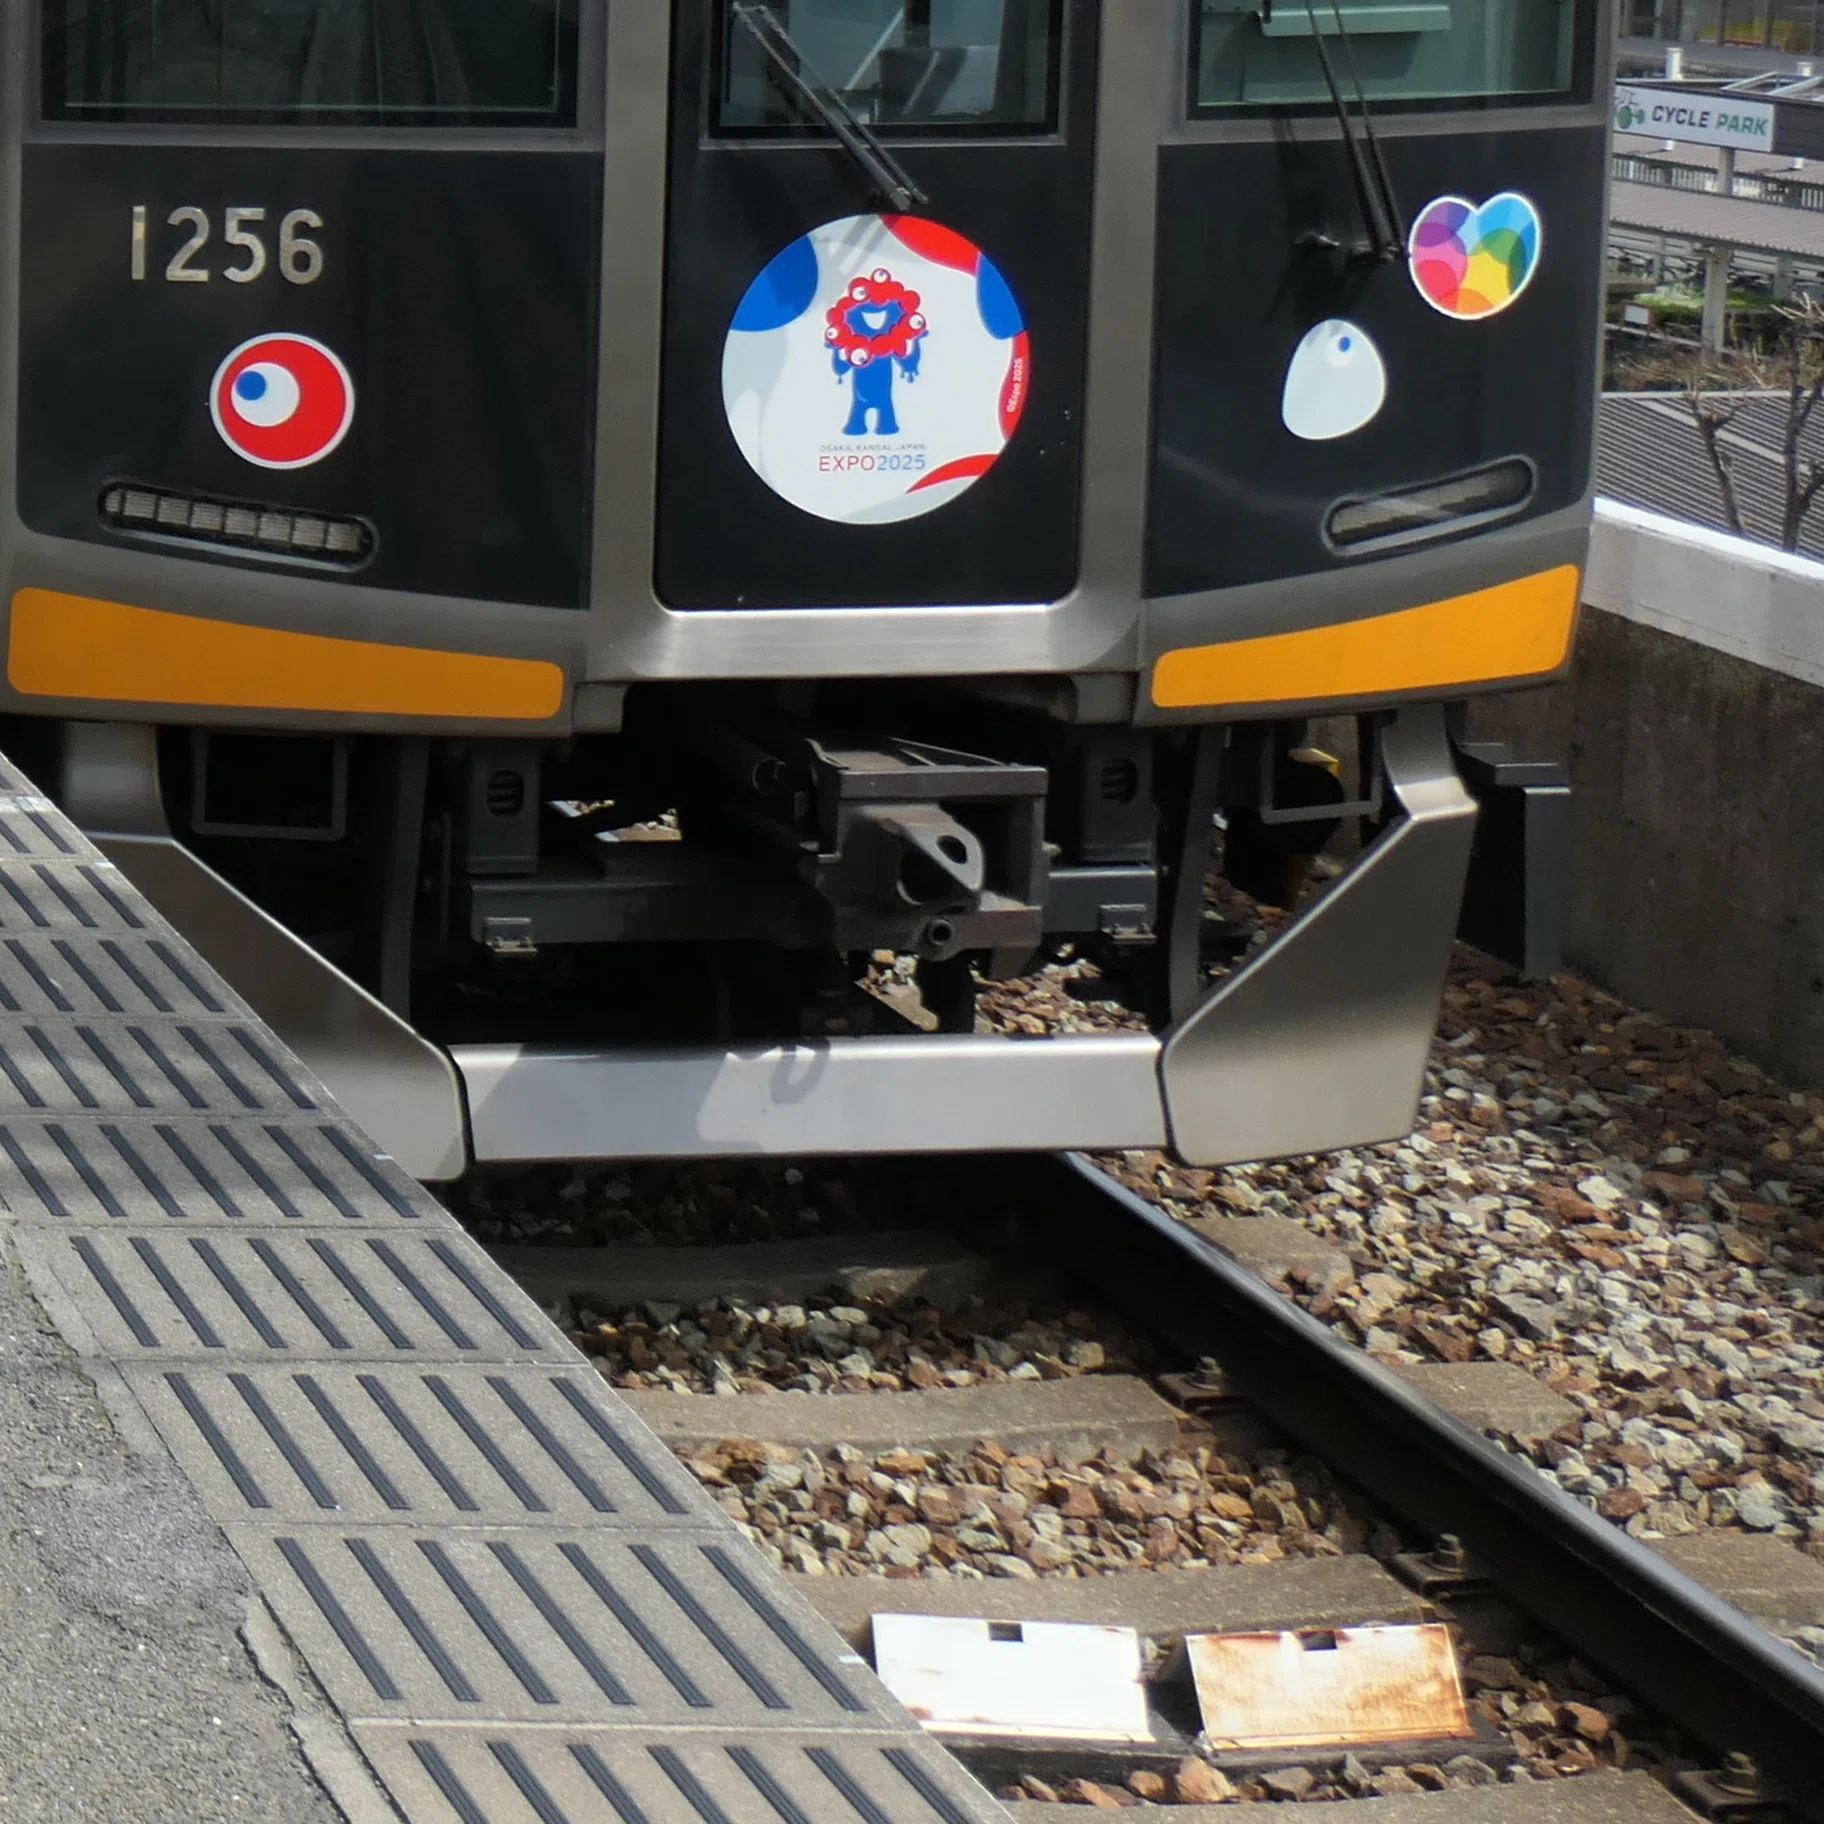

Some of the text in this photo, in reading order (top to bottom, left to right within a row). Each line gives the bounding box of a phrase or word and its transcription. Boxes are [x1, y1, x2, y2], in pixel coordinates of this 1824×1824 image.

[1652, 105, 1769, 136] CYCLE PARK
[131, 205, 324, 285] 1256
[1012, 357, 1023, 382] 2025
